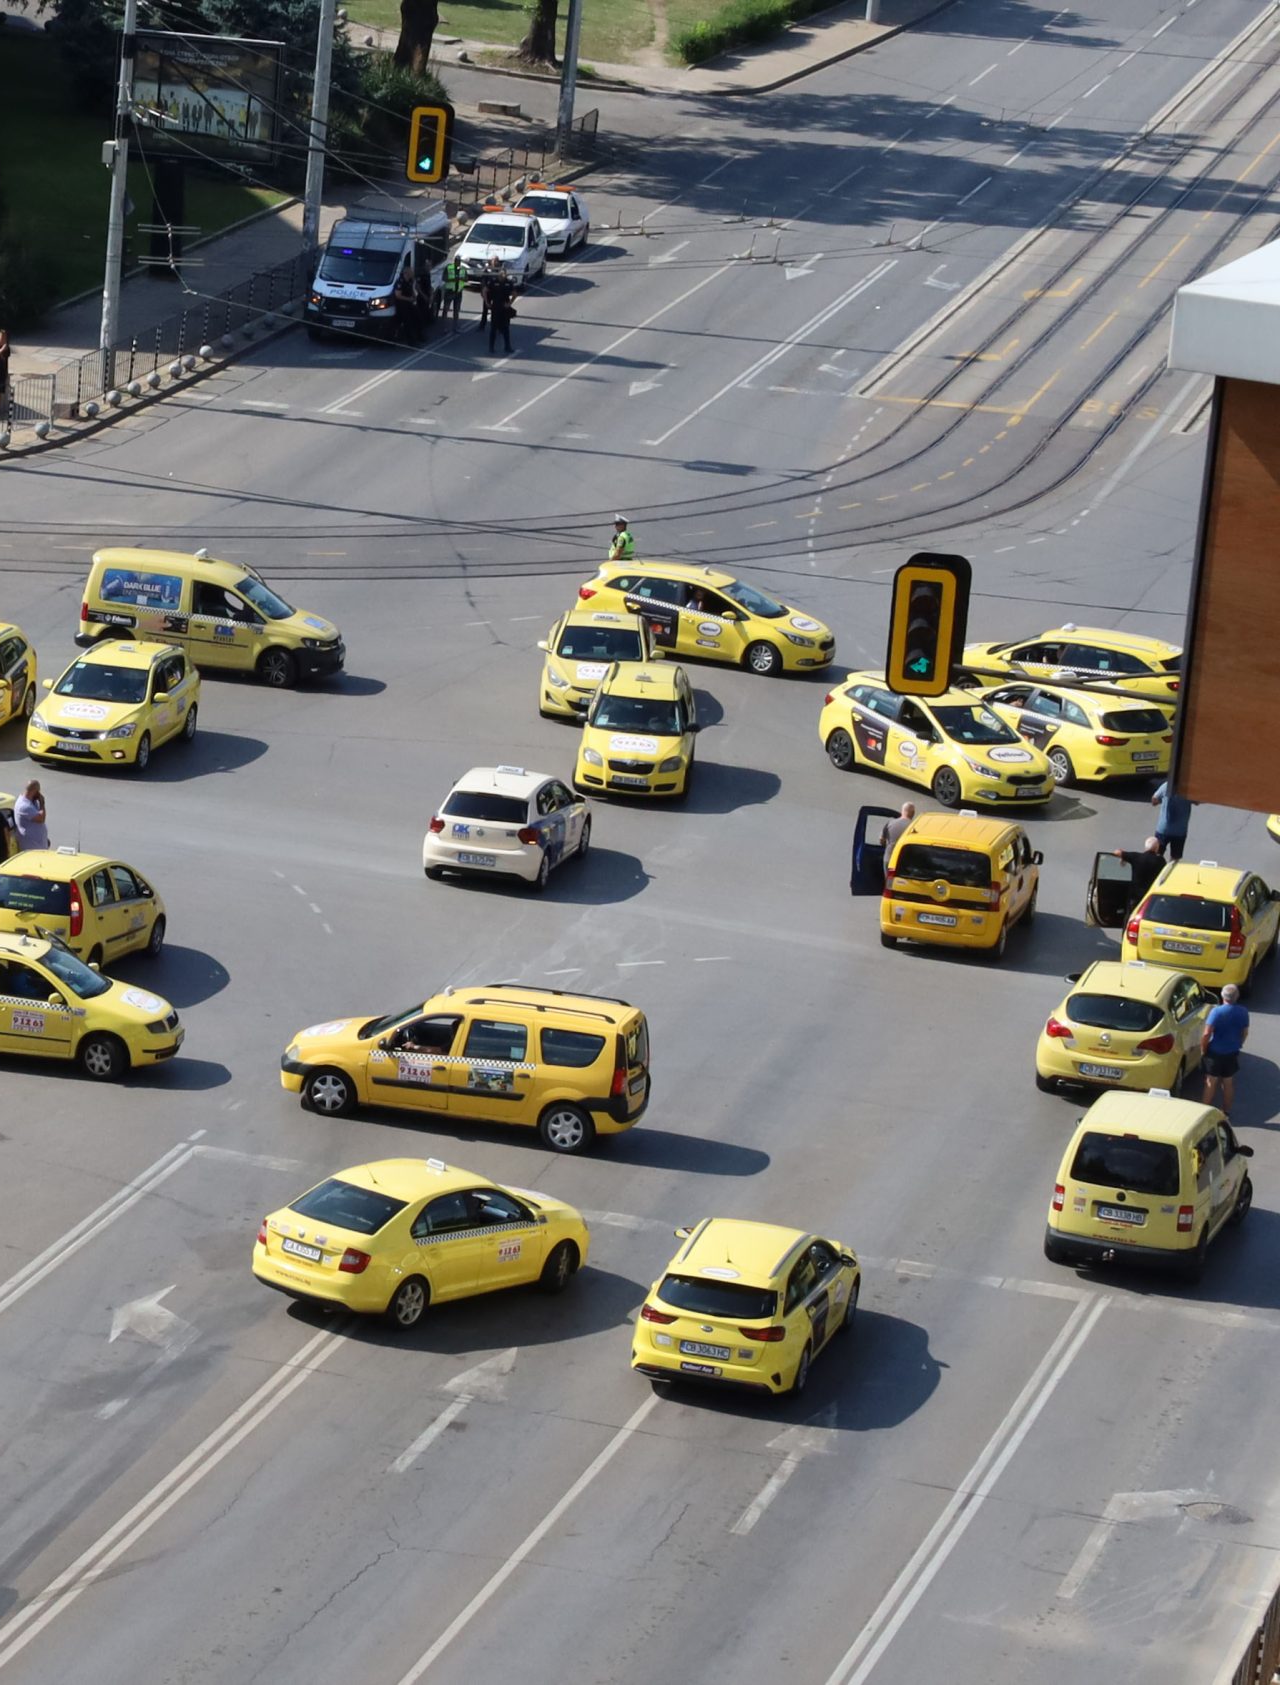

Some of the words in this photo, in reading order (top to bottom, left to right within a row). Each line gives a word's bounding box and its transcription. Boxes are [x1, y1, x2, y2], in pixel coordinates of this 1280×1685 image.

[330, 289, 368, 298] POLICE
[123, 581, 142, 590] DARK
[143, 583, 162, 592] BLUE
[453, 823, 471, 833] OK
[685, 1343, 696, 1352] CB
[699, 1345, 716, 1355] 3063
[717, 1349, 728, 1357] HC
